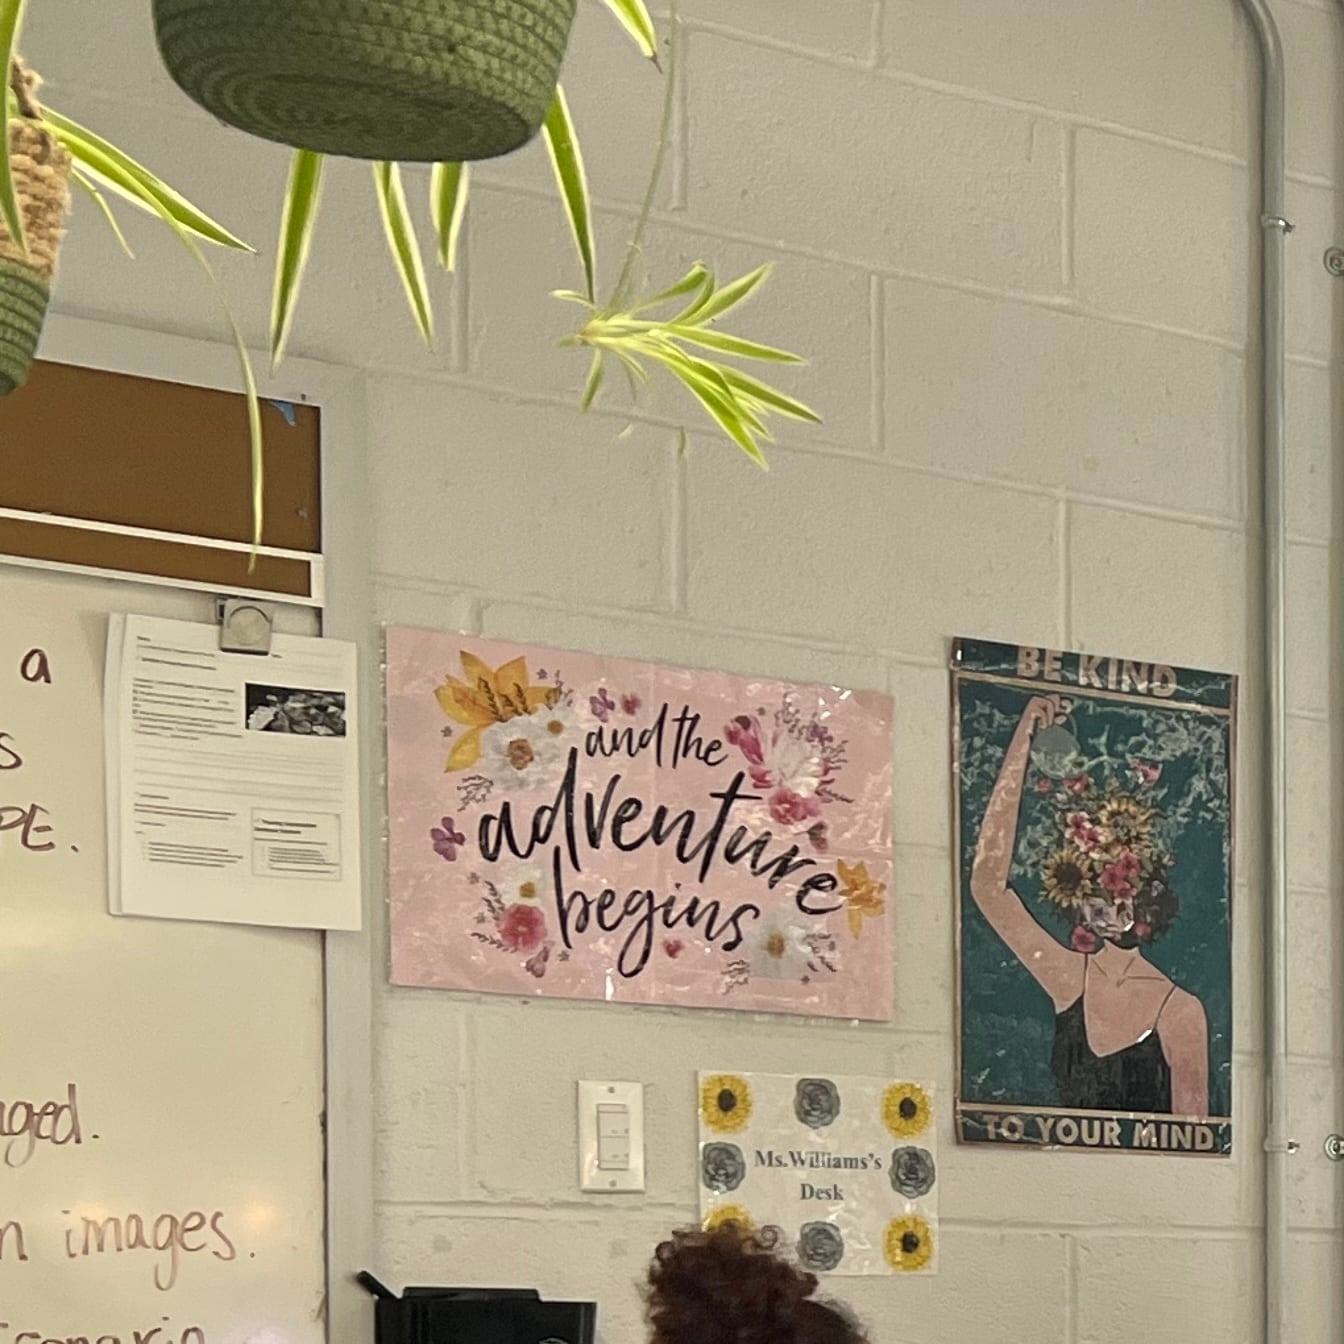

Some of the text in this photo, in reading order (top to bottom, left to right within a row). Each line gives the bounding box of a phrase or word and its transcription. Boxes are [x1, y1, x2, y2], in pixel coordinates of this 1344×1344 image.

[20, 648, 52, 684] a
[1017, 646, 1179, 698] BE KIND
[585, 702, 729, 768] and the
[478, 747, 844, 916] adventure
[553, 845, 761, 978] begins
[985, 1114, 1215, 1150] TO YOUR MIND
[800, 1183, 844, 1201] Desk
[61, 1210, 256, 1291] images.
